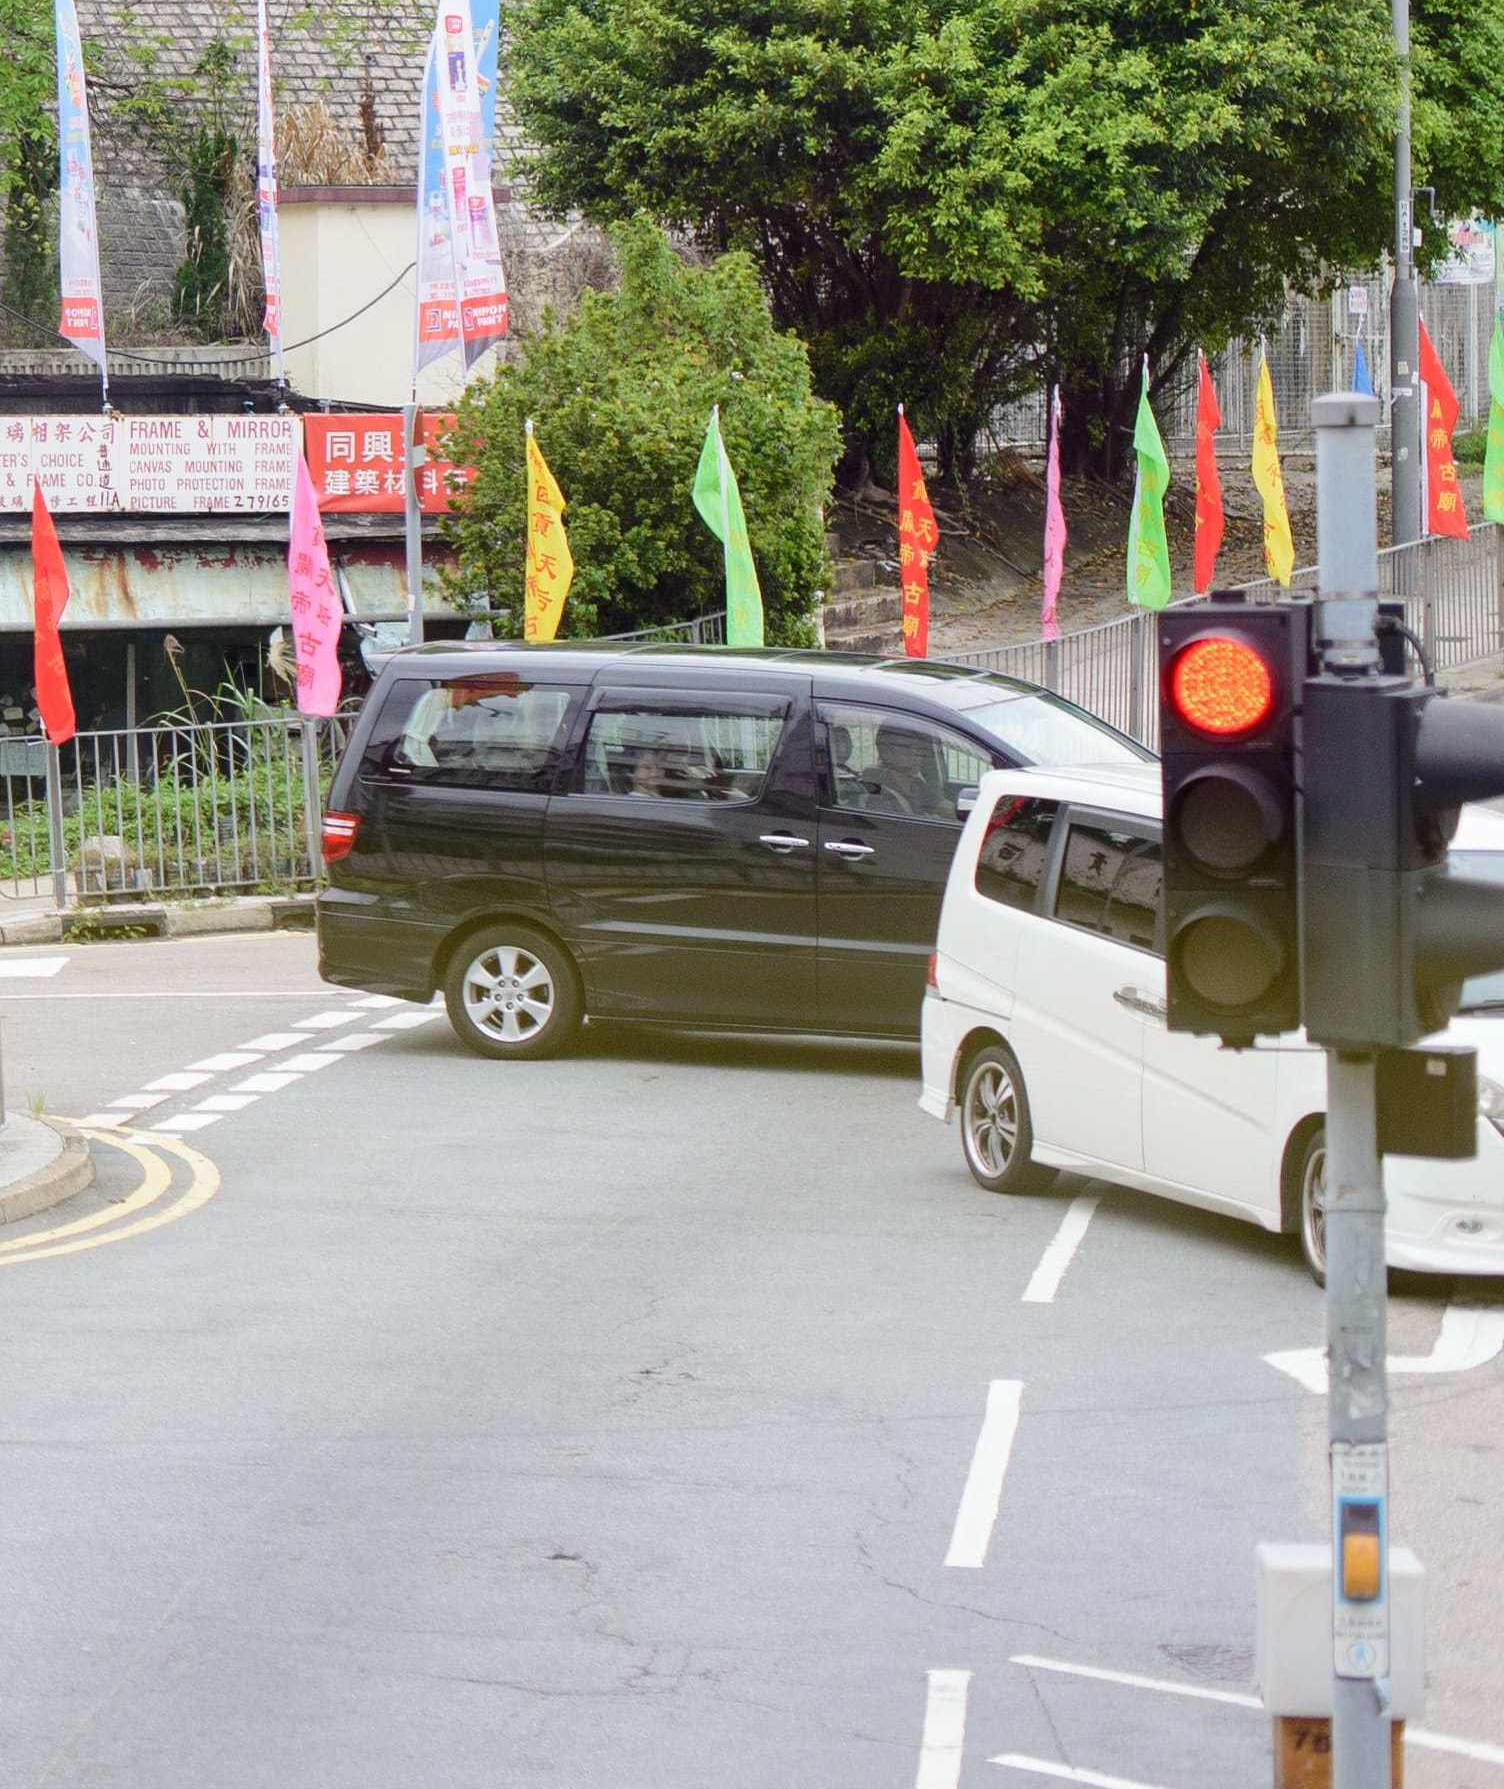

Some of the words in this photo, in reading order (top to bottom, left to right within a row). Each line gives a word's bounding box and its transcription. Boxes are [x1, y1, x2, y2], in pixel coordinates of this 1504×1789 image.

[129, 420, 182, 440] FRAME
[196, 419, 210, 439] &
[129, 442, 191, 456] MOUNTING
[207, 442, 237, 456] WITH
[254, 442, 292, 455] FRAME
[40, 452, 85, 468] CHOICE
[129, 460, 173, 474] CANVAS
[184, 460, 243, 474] MOUNTING
[254, 460, 292, 474] FRAME
[6, 472, 16, 487] &
[76, 472, 98, 488] CO.
[129, 478, 166, 491] PHOTO
[176, 478, 245, 491] PROTECTION
[254, 477, 292, 491] FRAME
[130, 495, 177, 510] PICTURE
[193, 495, 230, 510] FRAME
